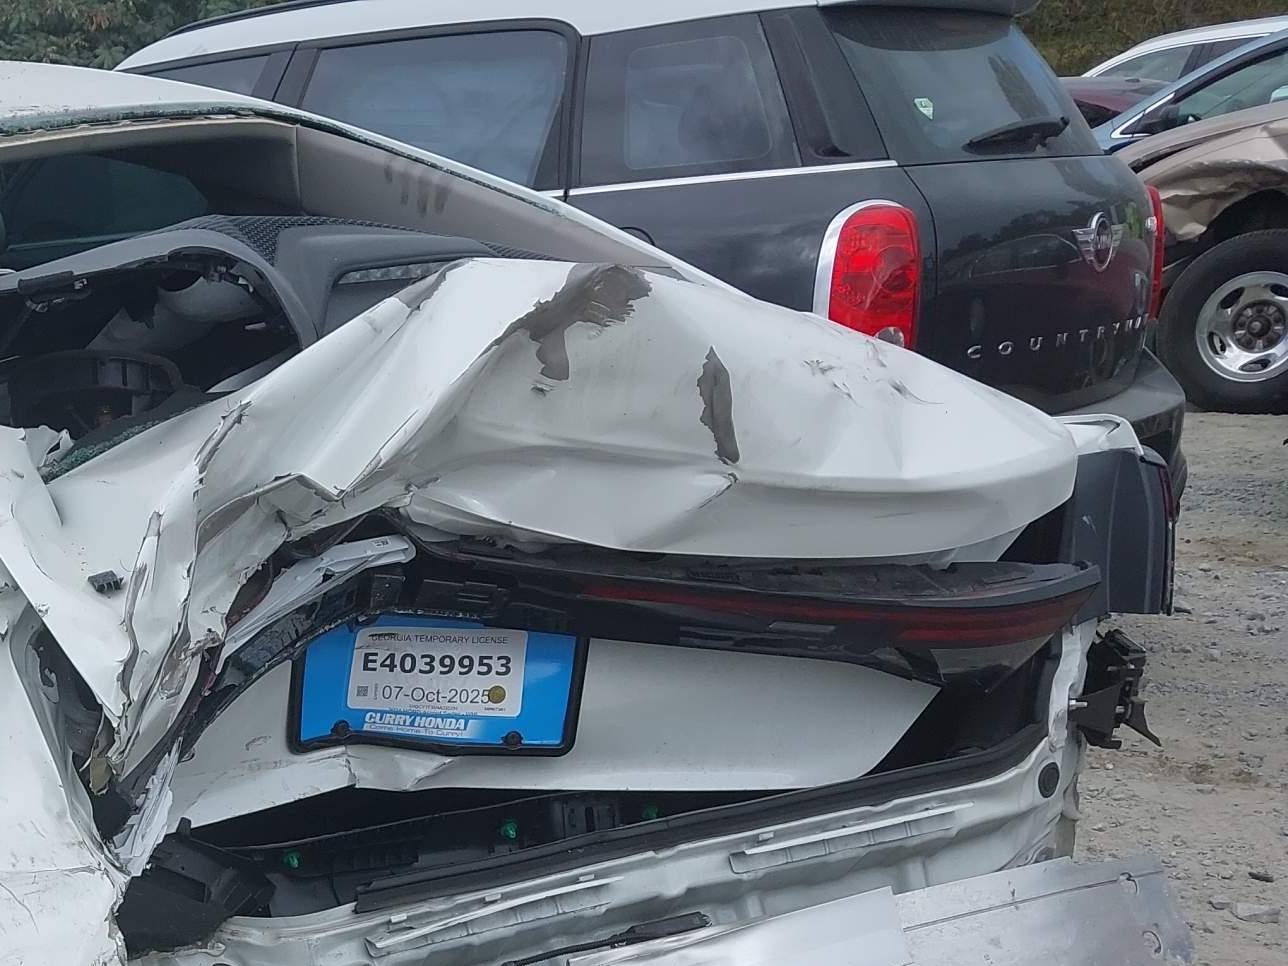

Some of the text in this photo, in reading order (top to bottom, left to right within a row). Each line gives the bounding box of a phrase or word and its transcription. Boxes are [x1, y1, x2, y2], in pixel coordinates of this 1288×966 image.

[372, 634, 509, 645] GEORGIA TEMPORARY LICENSE
[362, 652, 512, 676] E4039953
[382, 685, 490, 704] 07-Oct-2025
[365, 712, 465, 730] CURRY HONDA
[396, 726, 421, 734] Home
